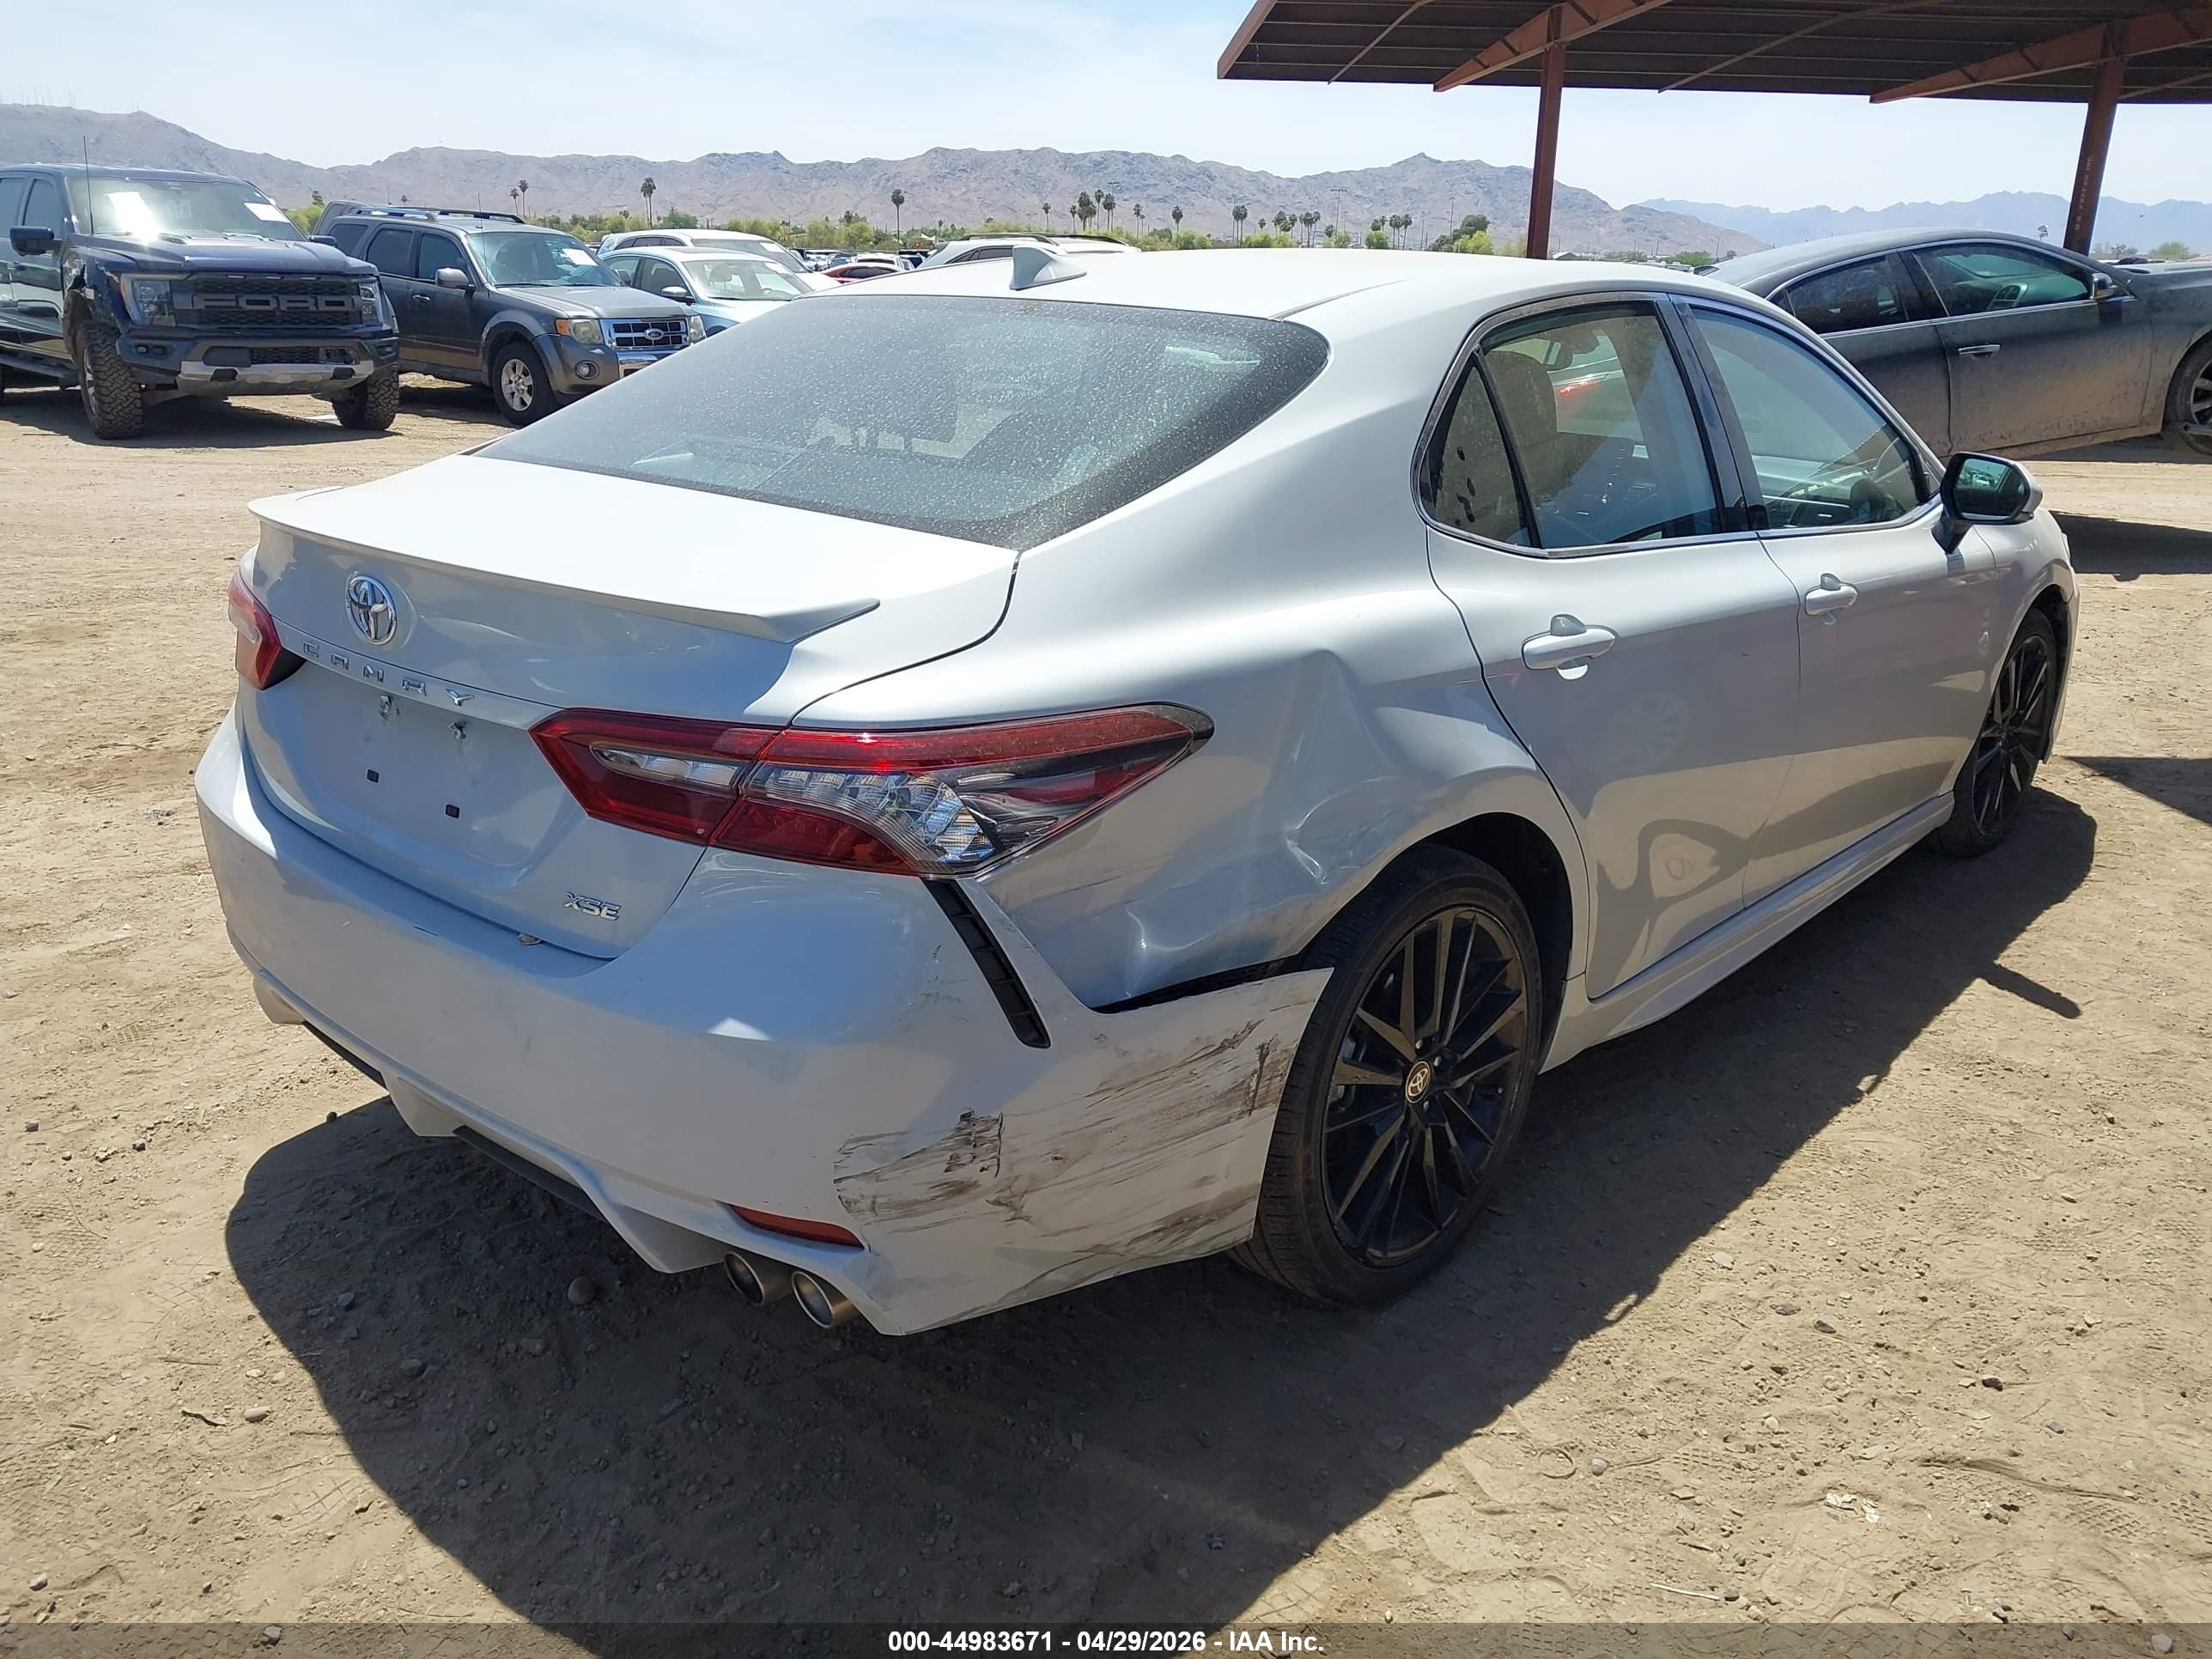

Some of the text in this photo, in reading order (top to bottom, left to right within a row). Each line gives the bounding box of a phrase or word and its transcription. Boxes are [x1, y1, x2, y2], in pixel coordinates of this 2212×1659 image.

[192, 295, 356, 311] FORD
[303, 642, 476, 707] CAMRY
[563, 891, 621, 921] XSE
